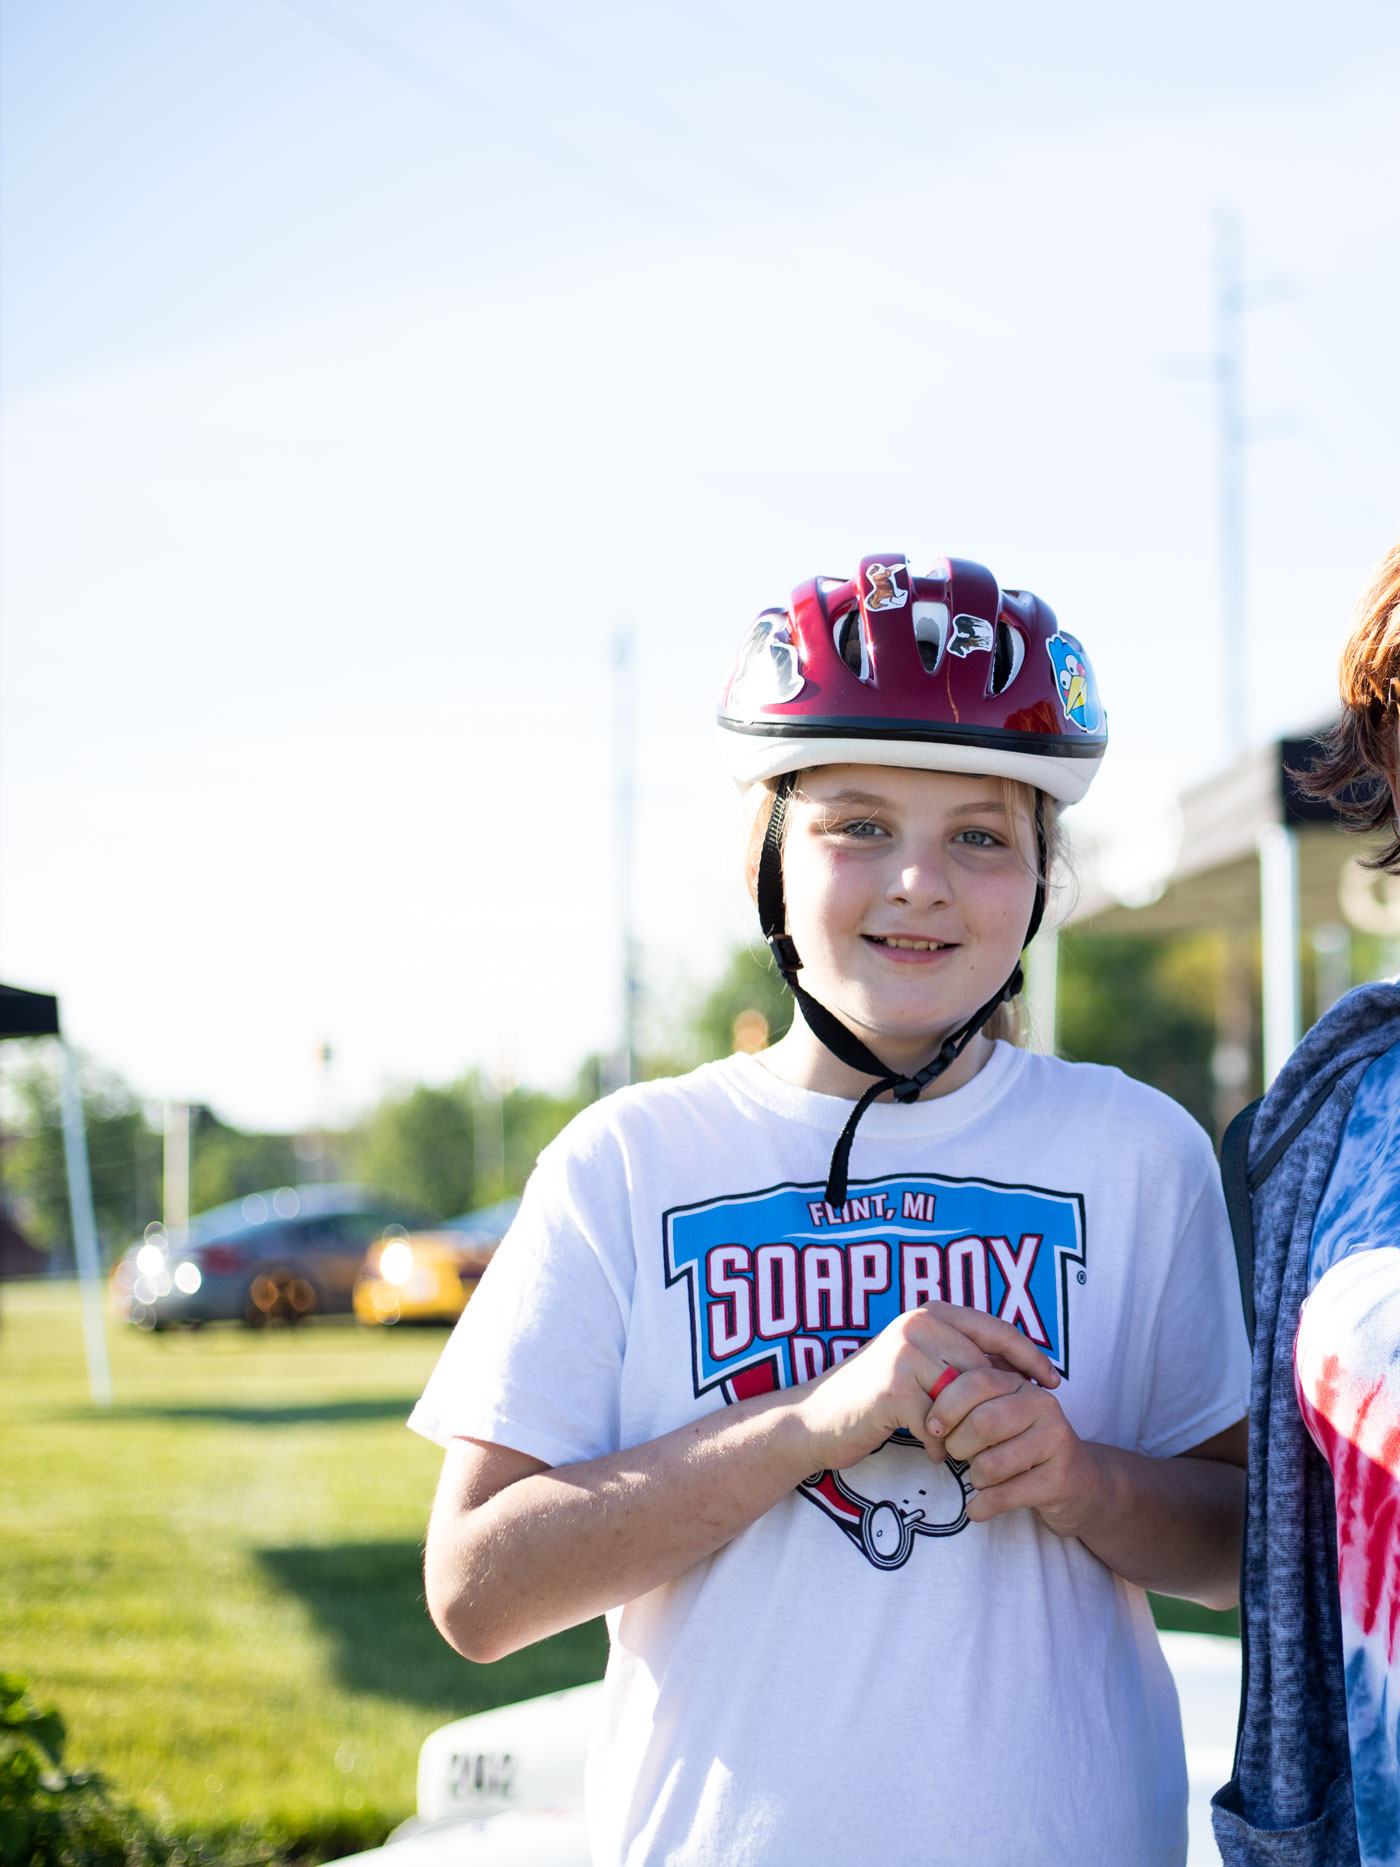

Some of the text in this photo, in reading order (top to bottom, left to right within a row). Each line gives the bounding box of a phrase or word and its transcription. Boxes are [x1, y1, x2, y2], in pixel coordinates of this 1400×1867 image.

[807, 1191, 936, 1227] FLINT, MI
[706, 1241, 891, 1361] SOAP
[899, 1234, 1054, 1351] BOX
